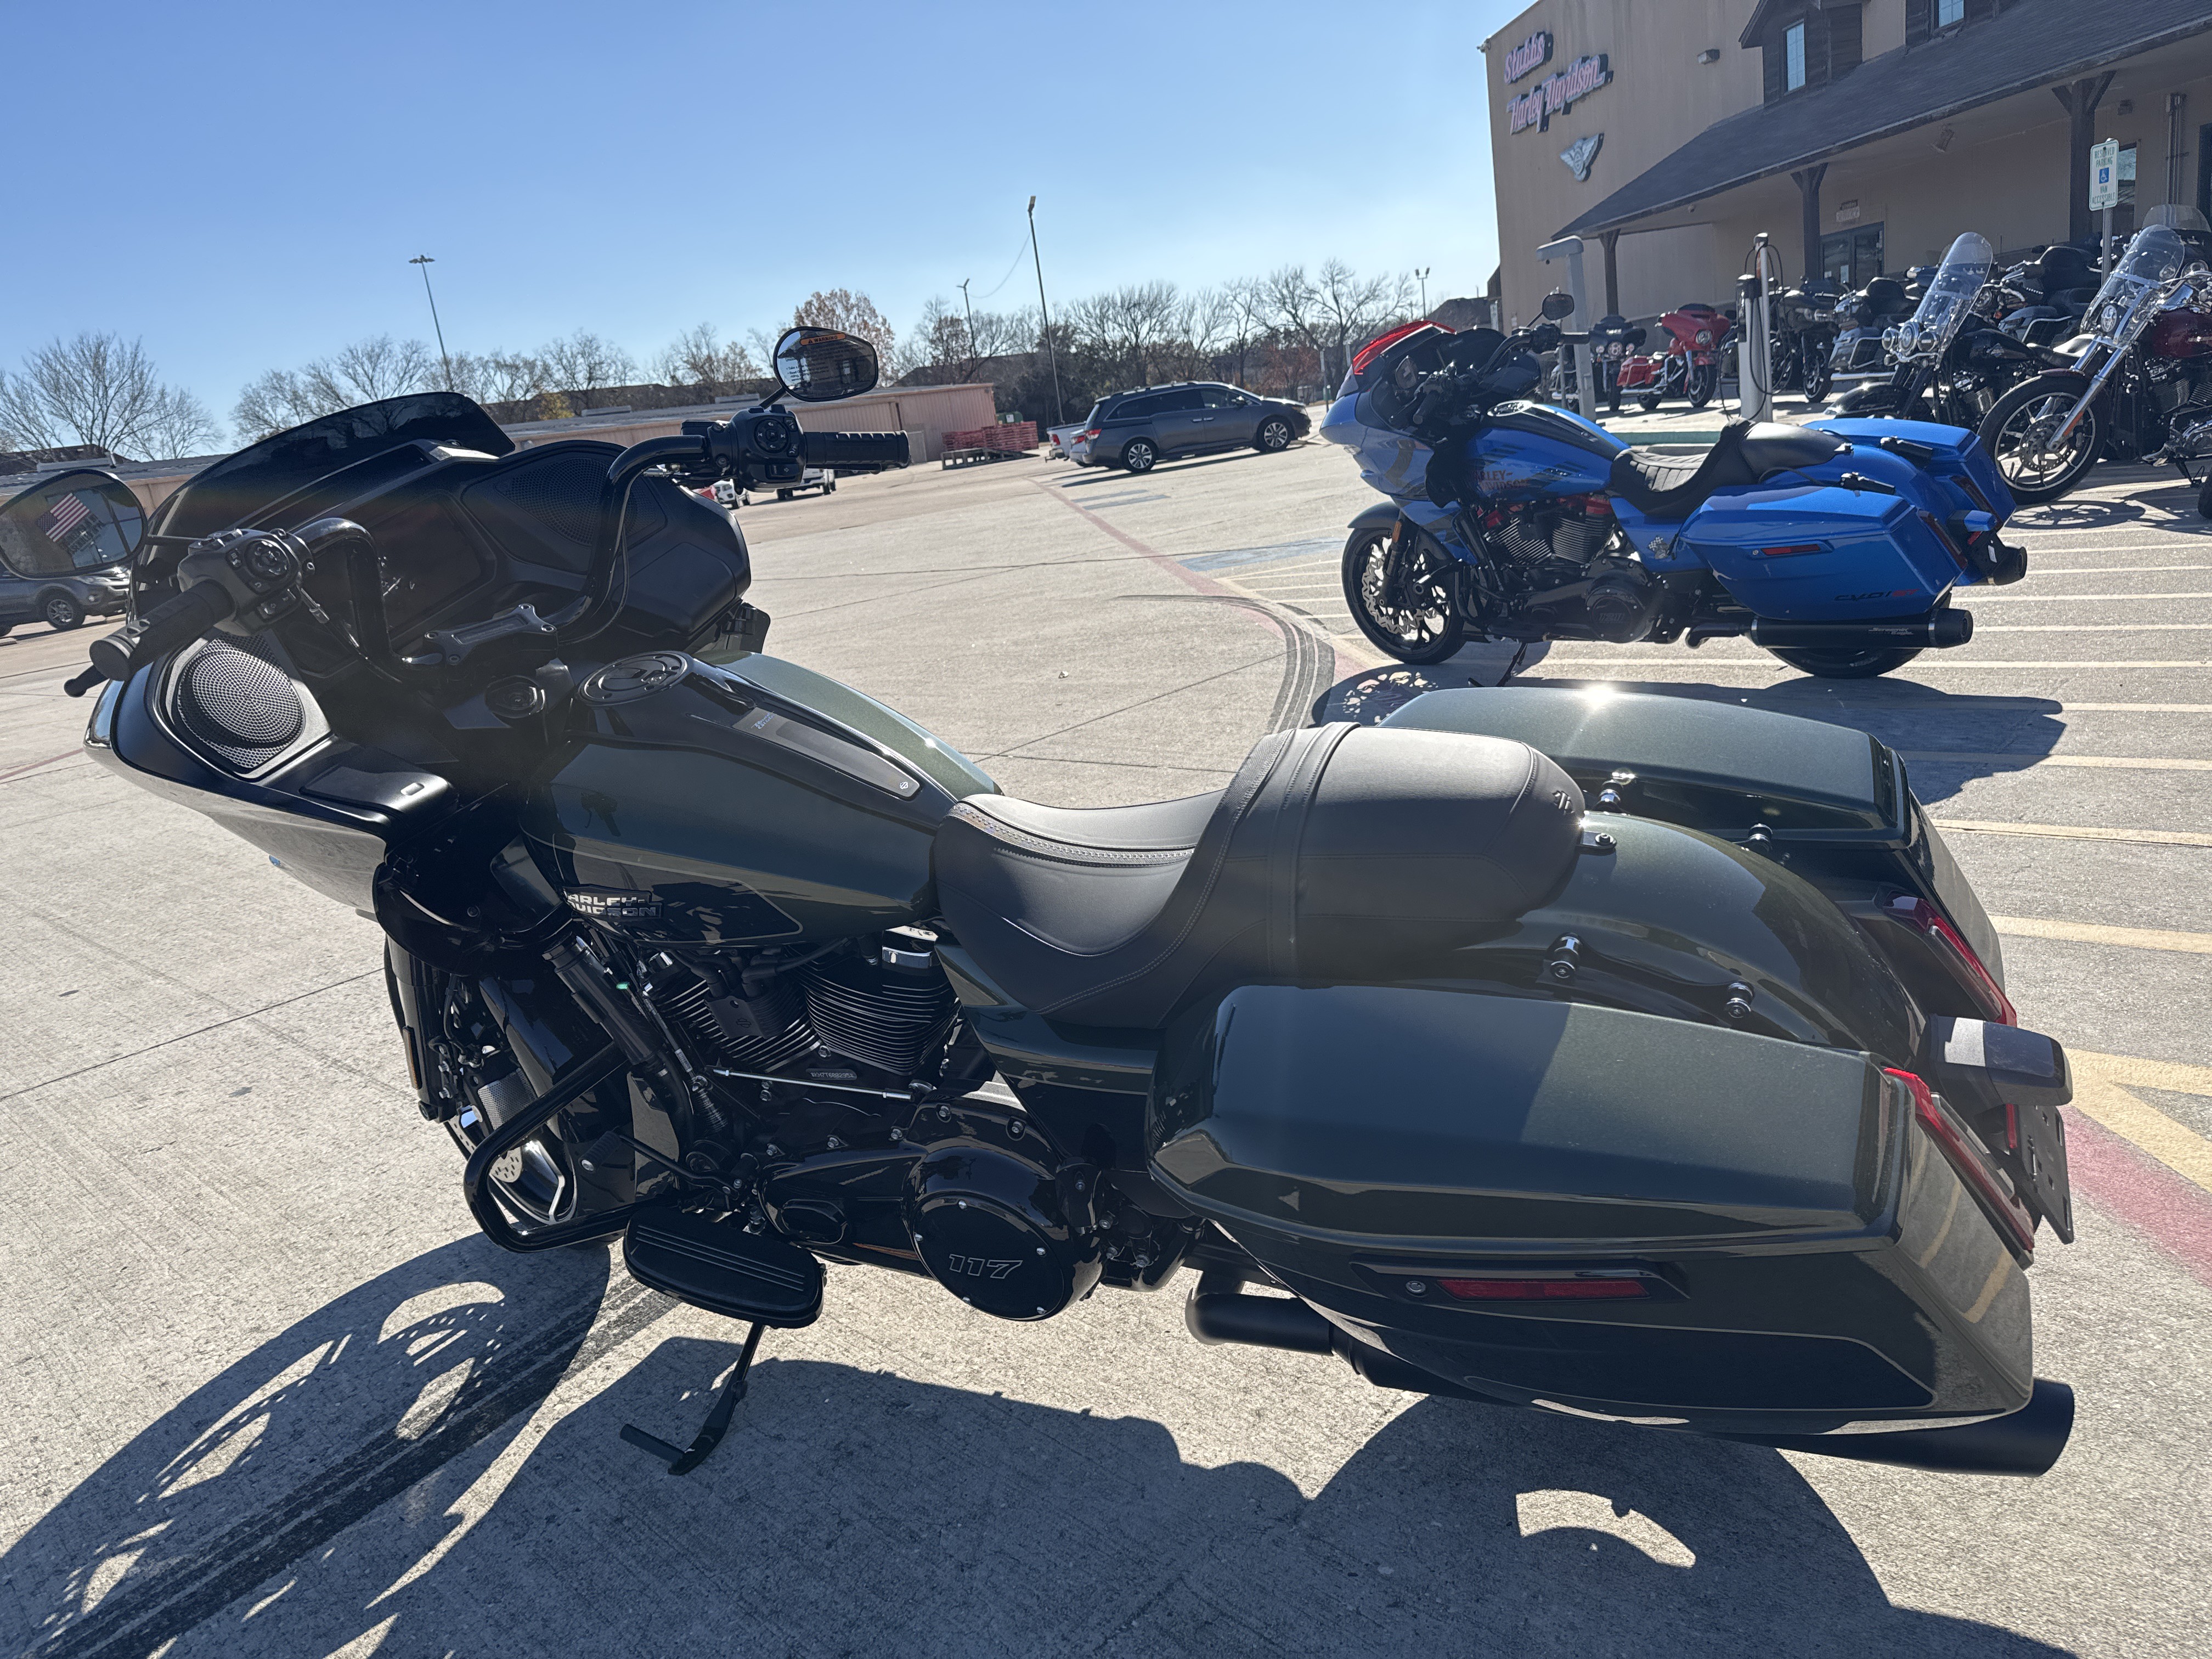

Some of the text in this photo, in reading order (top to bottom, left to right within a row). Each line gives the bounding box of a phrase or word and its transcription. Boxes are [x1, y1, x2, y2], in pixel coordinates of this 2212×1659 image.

[1504, 31, 1547, 84] Stubbs
[1506, 86, 1546, 136] Harley
[2094, 146, 2115, 159] RESERVED
[2096, 156, 2113, 168] PARKING
[2100, 185, 2108, 194] VAN
[2092, 192, 2115, 205] ACCESSIBLE
[563, 890, 645, 907] ARLEY-
[567, 900, 657, 917] VIDSON
[949, 1253, 1023, 1279] 117
